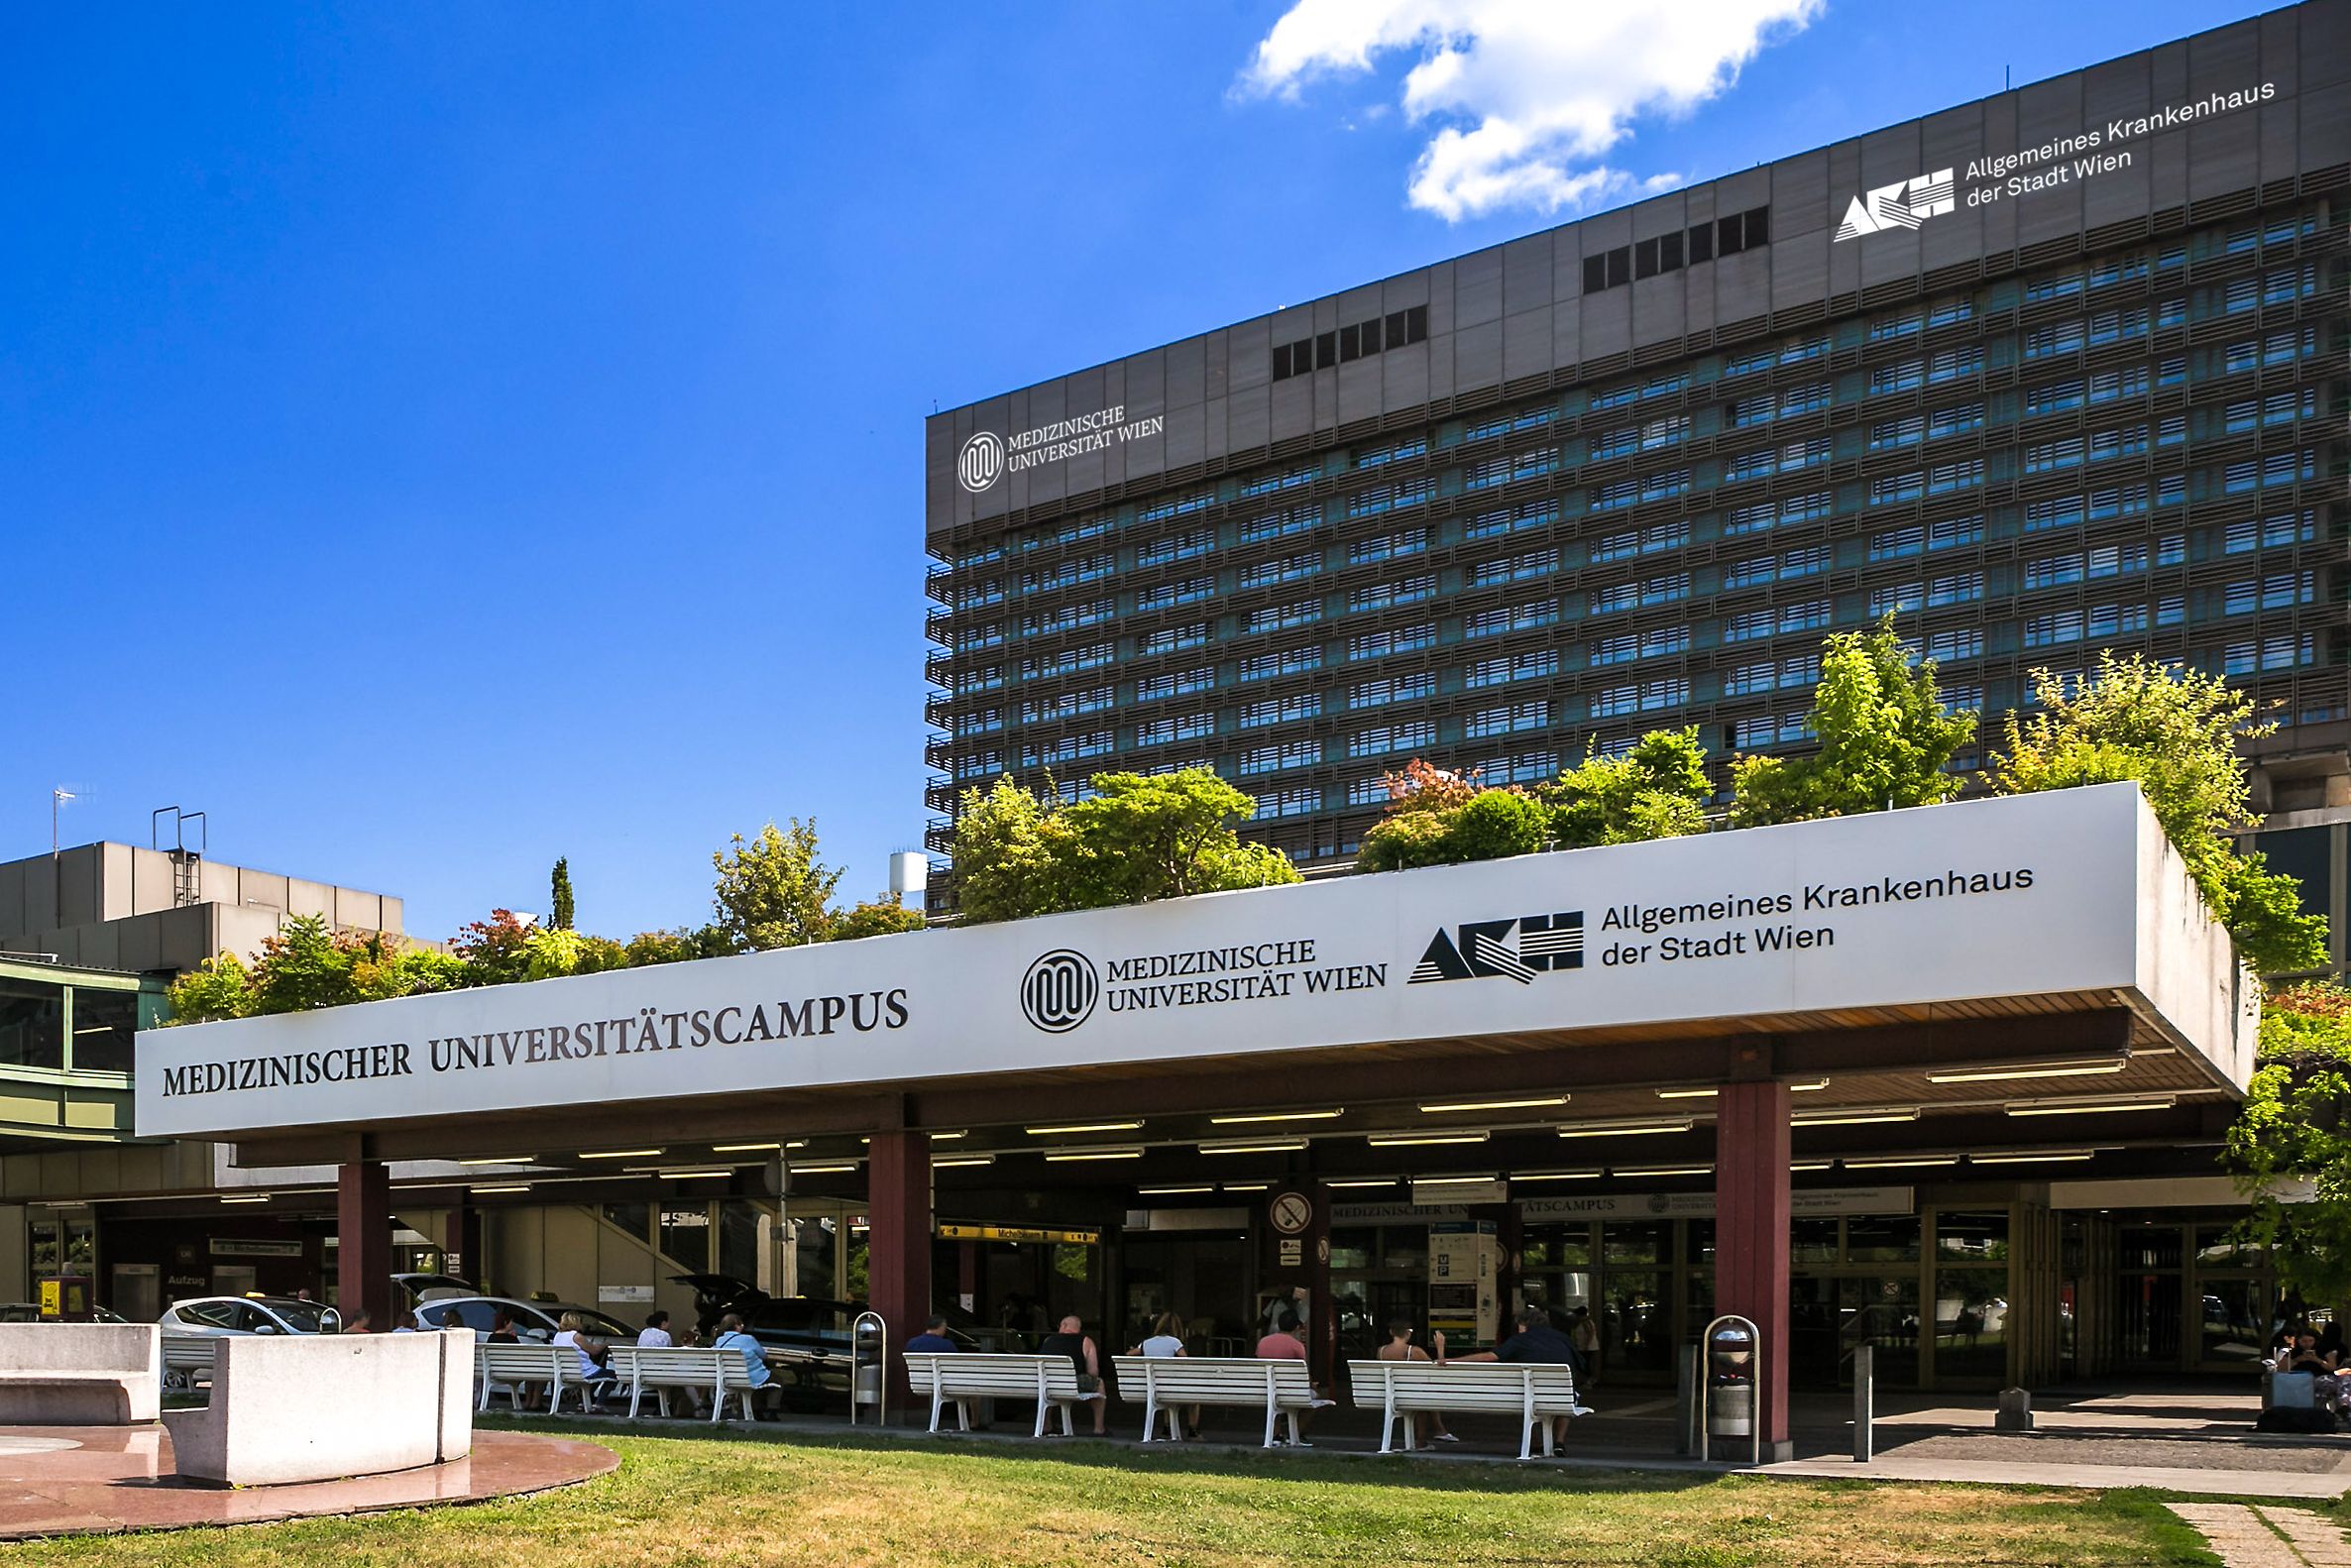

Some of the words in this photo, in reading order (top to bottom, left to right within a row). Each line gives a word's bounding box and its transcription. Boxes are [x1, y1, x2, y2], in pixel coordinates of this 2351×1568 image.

[1965, 131, 2100, 180] Allgemeines
[2108, 82, 2275, 142] Krankenhaus
[1966, 186, 2001, 207] der
[2007, 167, 2069, 196] Stadt
[2074, 152, 2132, 179] Wien
[1008, 404, 1125, 452] MEDIZINISCHE
[1008, 429, 1113, 473] UNIVERSITÄT
[1117, 415, 1164, 443] WIEN
[1601, 893, 1793, 934] Allgemeines
[1804, 868, 2034, 911] Krankenhaus
[1106, 939, 1316, 983] MEDIZINISCHE
[1602, 942, 1652, 966] der
[1659, 931, 1746, 961] Stadt
[1754, 924, 1835, 952] Wien
[1106, 969, 1295, 1012] UNIVERSITÄT
[1304, 962, 1389, 994] WIEN
[162, 1043, 413, 1097] MEDIZINISCHER
[427, 988, 909, 1072] UNIVERSITÄTSCAMPUS
[1332, 1204, 1442, 1218] MEDIZINISCHER
[168, 1276, 205, 1287] Aufzug
